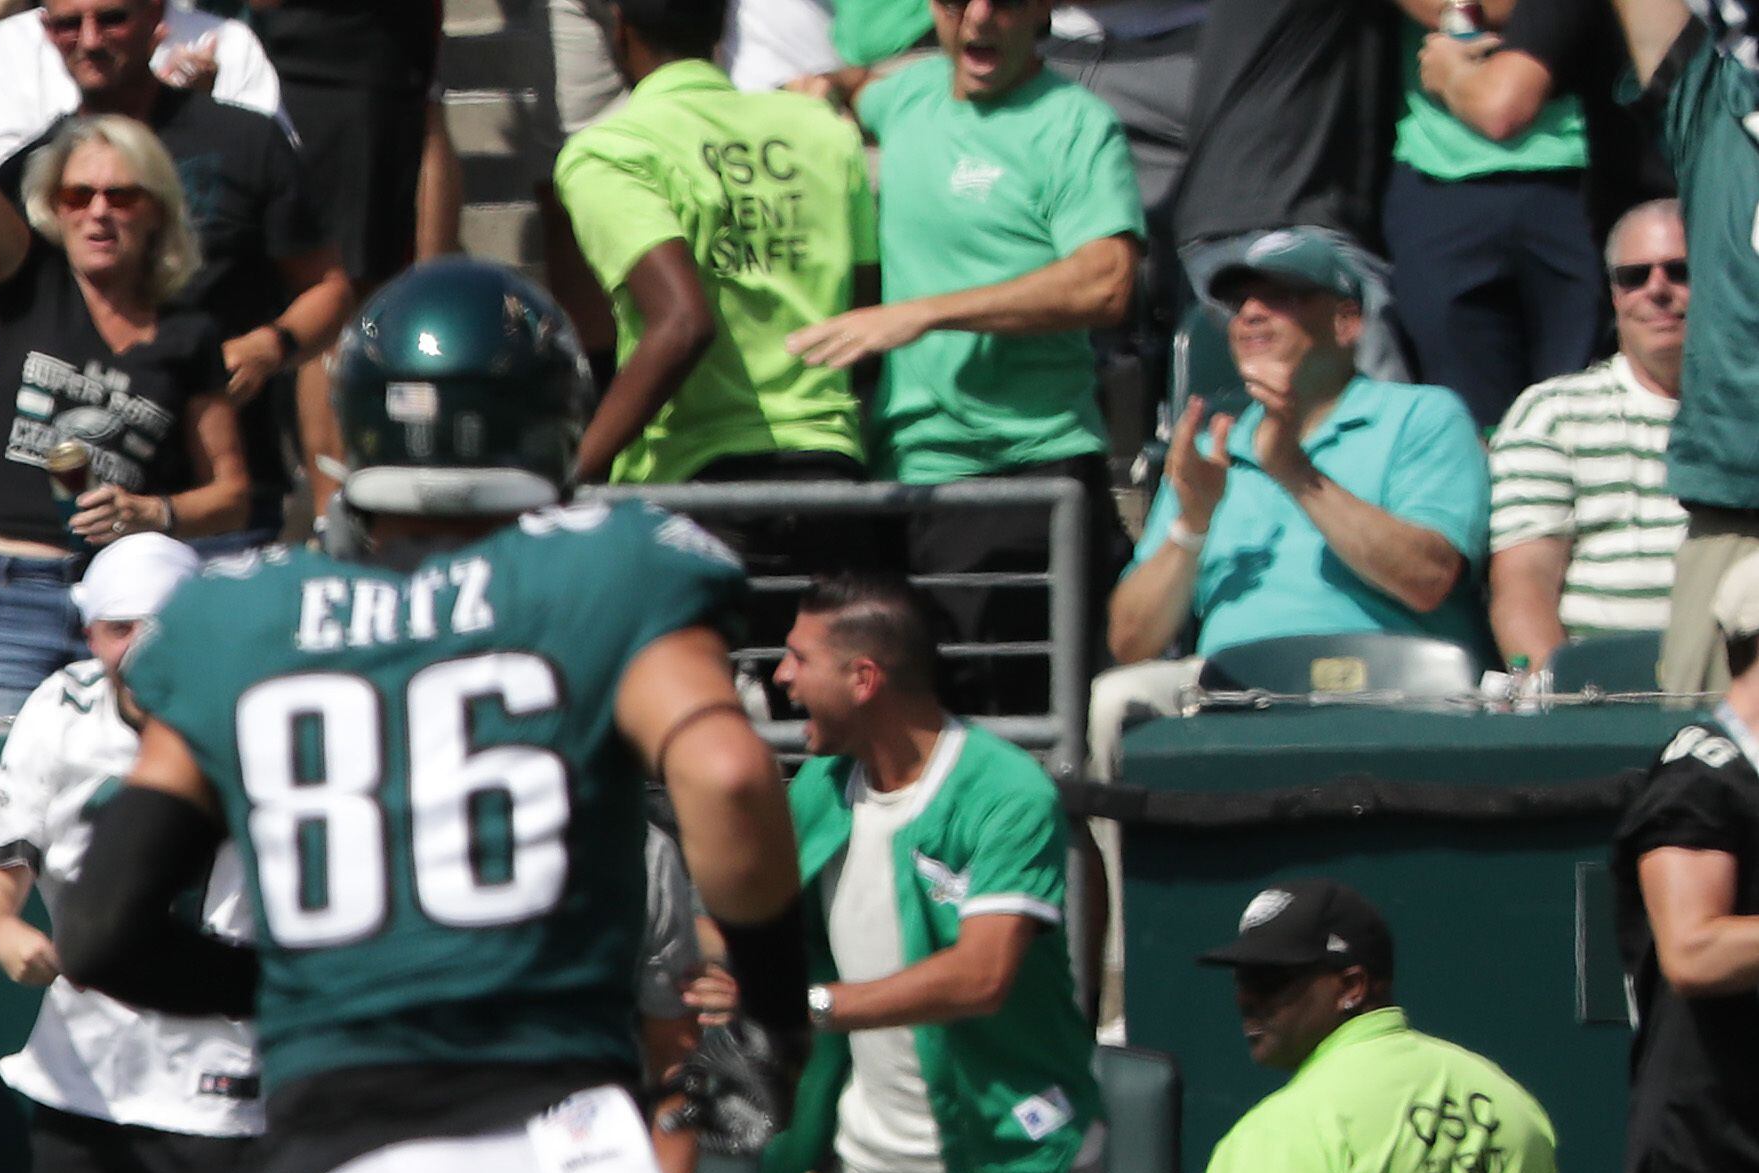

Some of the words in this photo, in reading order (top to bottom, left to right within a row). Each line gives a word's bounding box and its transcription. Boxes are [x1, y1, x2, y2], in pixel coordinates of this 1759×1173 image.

[711, 238, 807, 278] SAFF
[296, 556, 494, 650] ERTZ
[233, 650, 571, 950] 86
